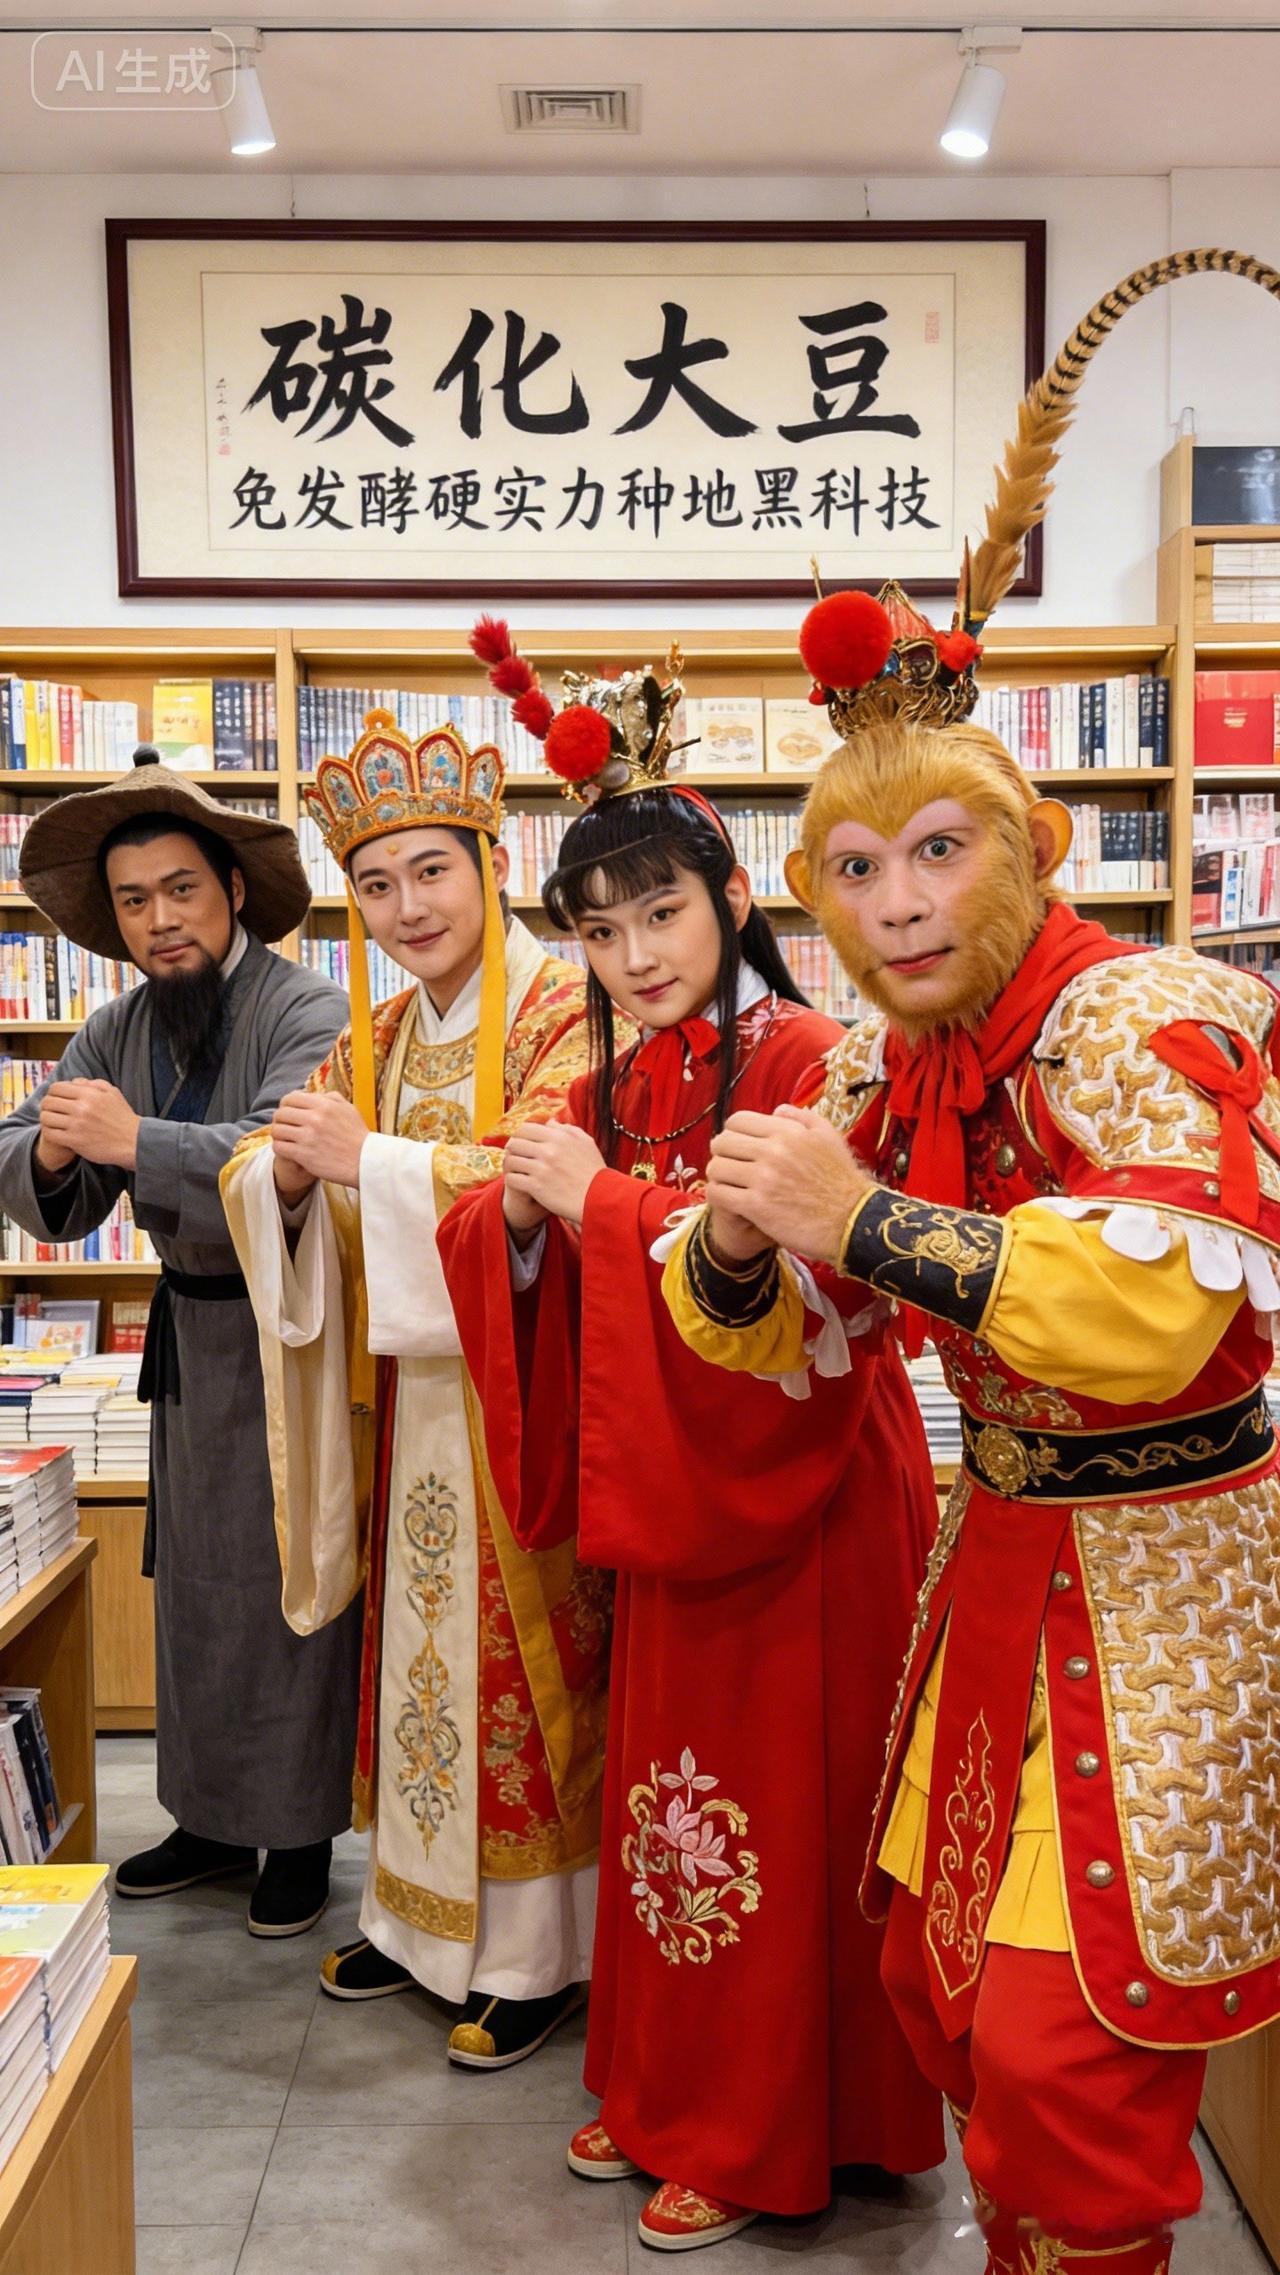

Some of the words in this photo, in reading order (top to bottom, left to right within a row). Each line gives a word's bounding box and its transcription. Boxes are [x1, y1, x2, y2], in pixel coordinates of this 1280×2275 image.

[241, 293, 921, 449] 碳化大豆
[229, 465, 940, 537] 免发酵硬实力种地黑科技
